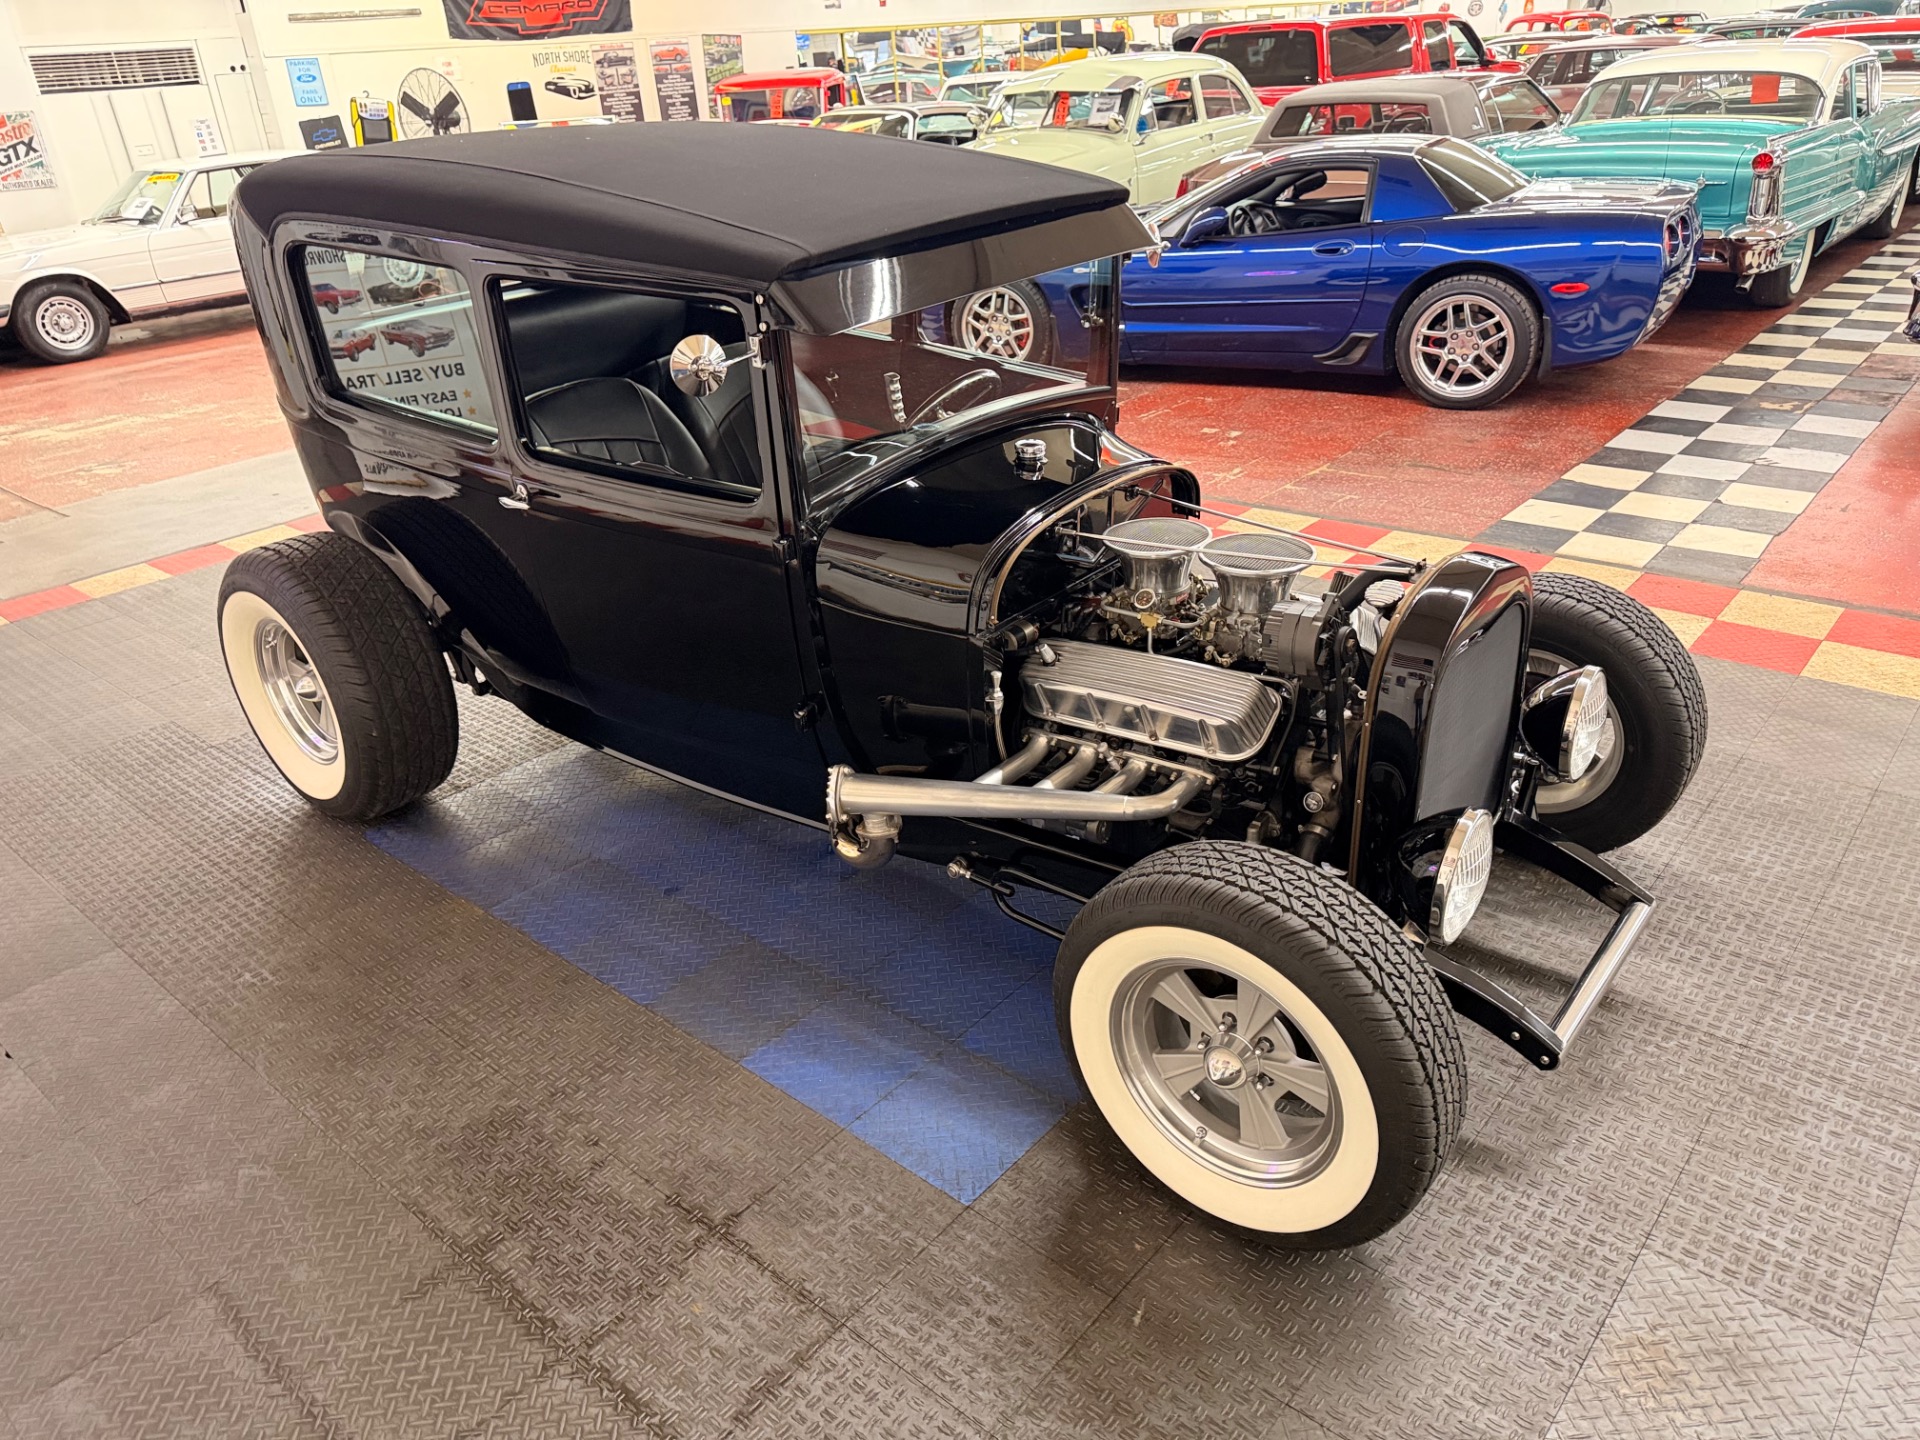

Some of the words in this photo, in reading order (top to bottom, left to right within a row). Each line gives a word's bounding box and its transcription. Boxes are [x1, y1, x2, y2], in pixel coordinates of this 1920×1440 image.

[488, 0, 593, 14] CAMARO
[532, 51, 562, 68] NORTH
[562, 49, 592, 64] SHORE
[0, 135, 39, 166] GTX
